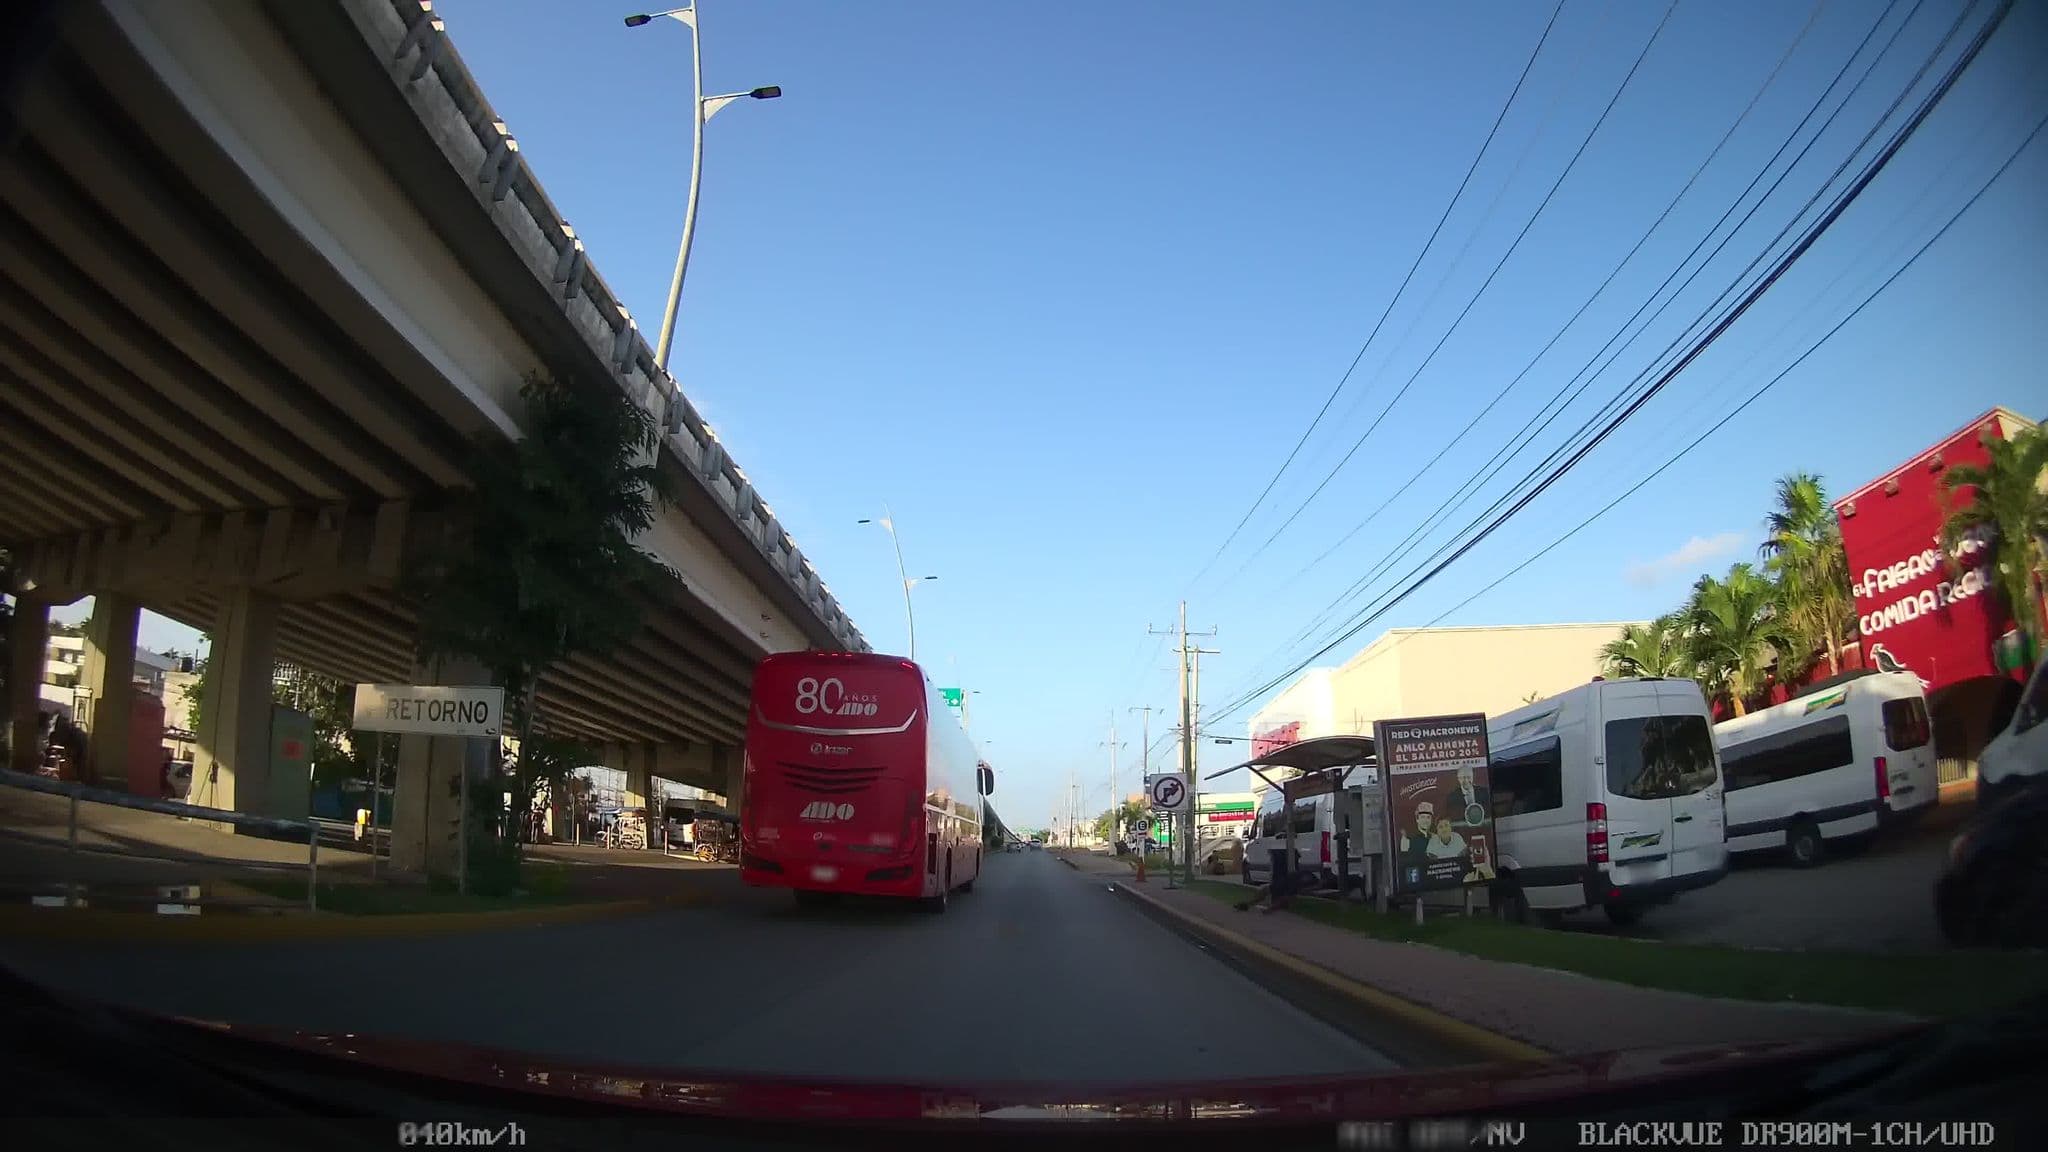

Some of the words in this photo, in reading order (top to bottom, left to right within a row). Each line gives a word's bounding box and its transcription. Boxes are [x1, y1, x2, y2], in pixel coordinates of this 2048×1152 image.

[1860, 590, 1937, 636] COMIDA
[795, 677, 844, 714] 80
[386, 697, 488, 724] RETORNO
[836, 702, 878, 716] ADO
[1391, 731, 1410, 739] RED
[1423, 725, 1480, 737] MACRONEWS
[1396, 743, 1426, 753] AMLO
[1429, 739, 1478, 750] AUMENTA
[1396, 753, 1409, 762] EL
[1412, 750, 1456, 761] SALARIO
[1459, 748, 1480, 757] 20%
[800, 801, 855, 820] ADO
